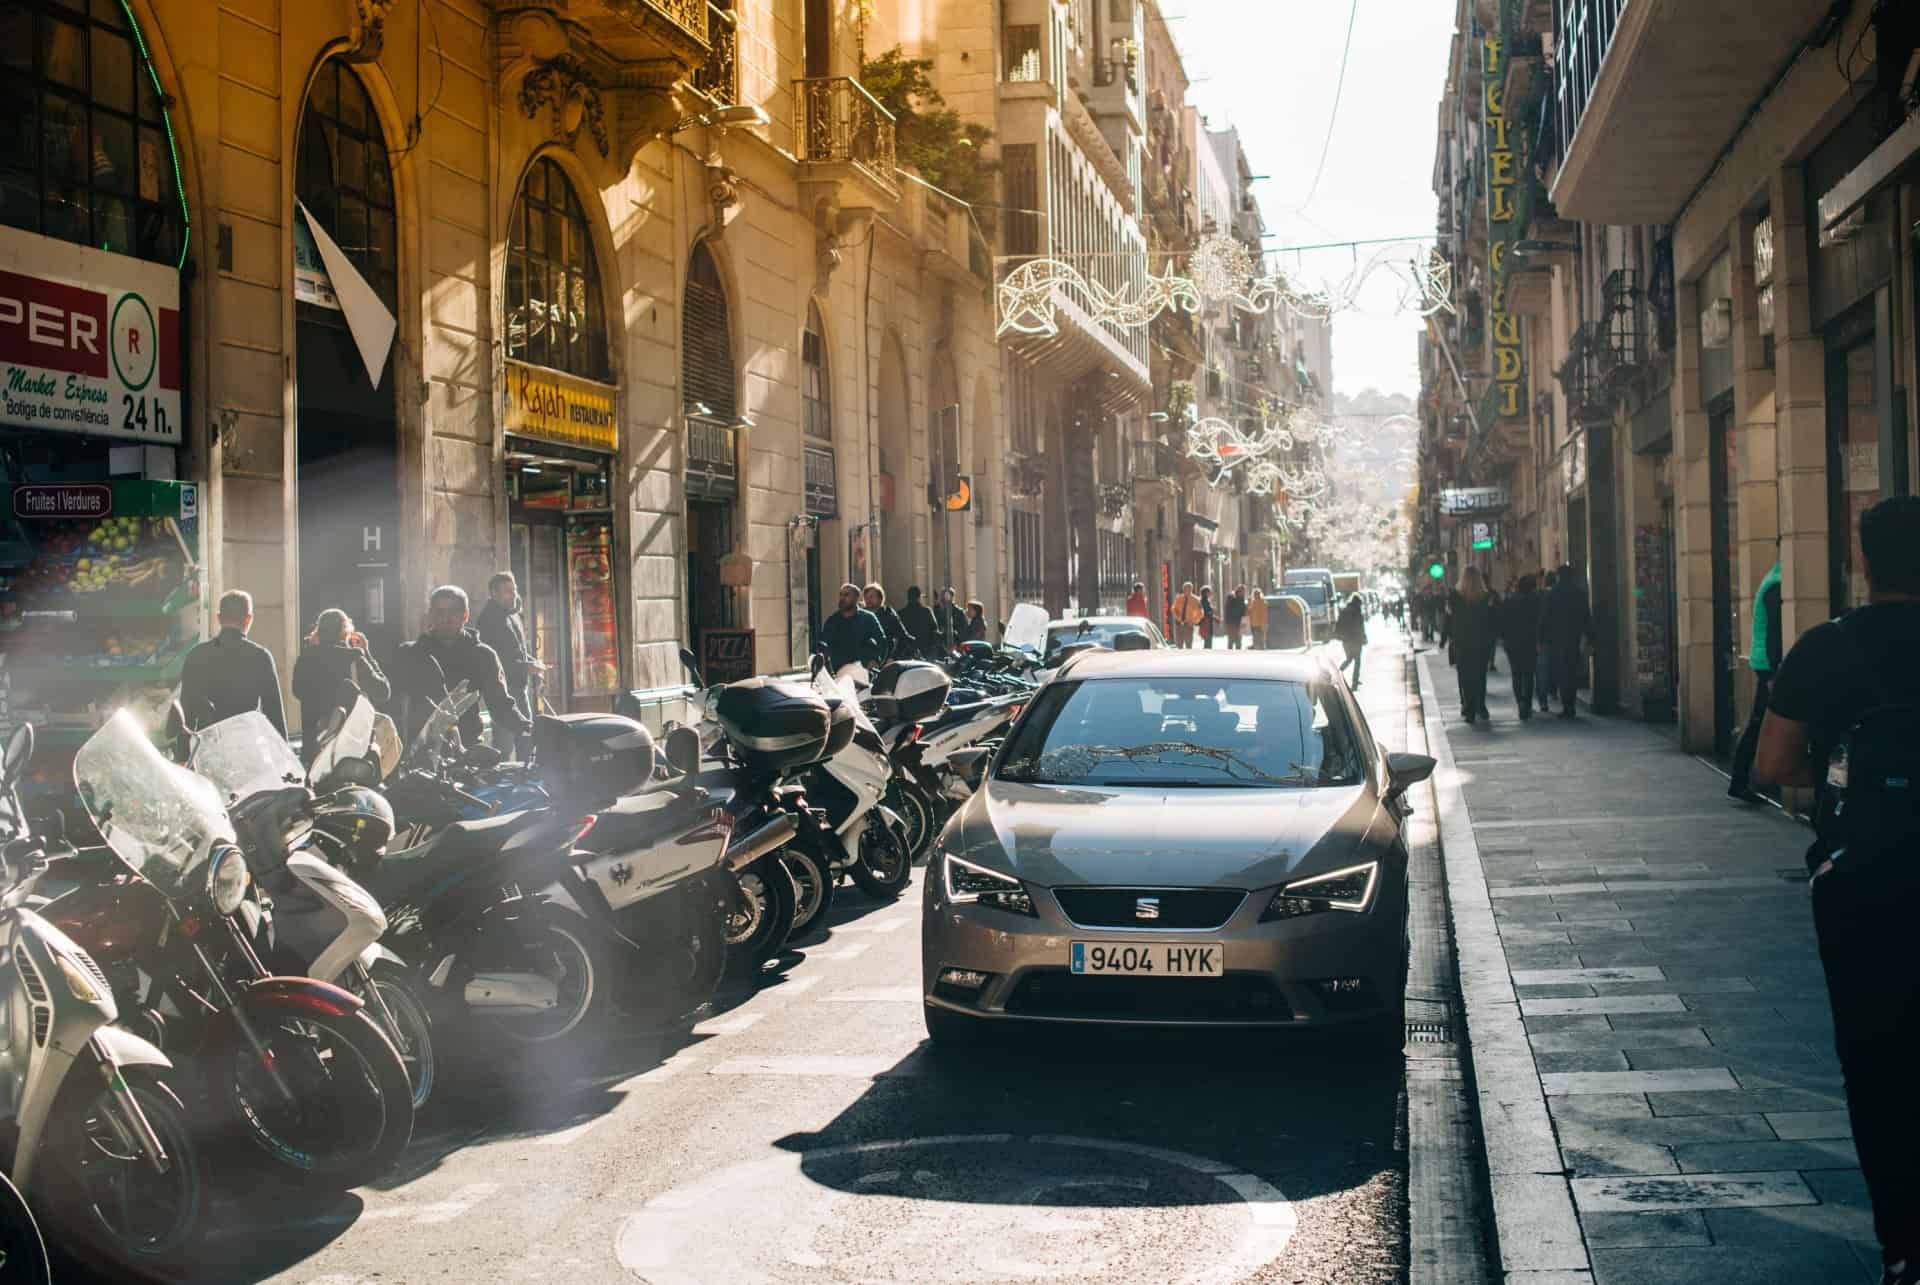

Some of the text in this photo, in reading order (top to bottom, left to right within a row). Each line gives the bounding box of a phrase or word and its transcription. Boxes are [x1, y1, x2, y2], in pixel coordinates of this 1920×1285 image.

[8, 366, 108, 404] Market Express
[519, 367, 566, 425] Rajah
[6, 399, 37, 420] Botiga
[39, 402, 51, 419] de
[123, 394, 173, 434] 24 h.
[25, 491, 55, 511] Fruites
[62, 490, 101, 511] Verdures
[363, 526, 381, 551] H
[1091, 947, 1214, 972] 9404 HYK
